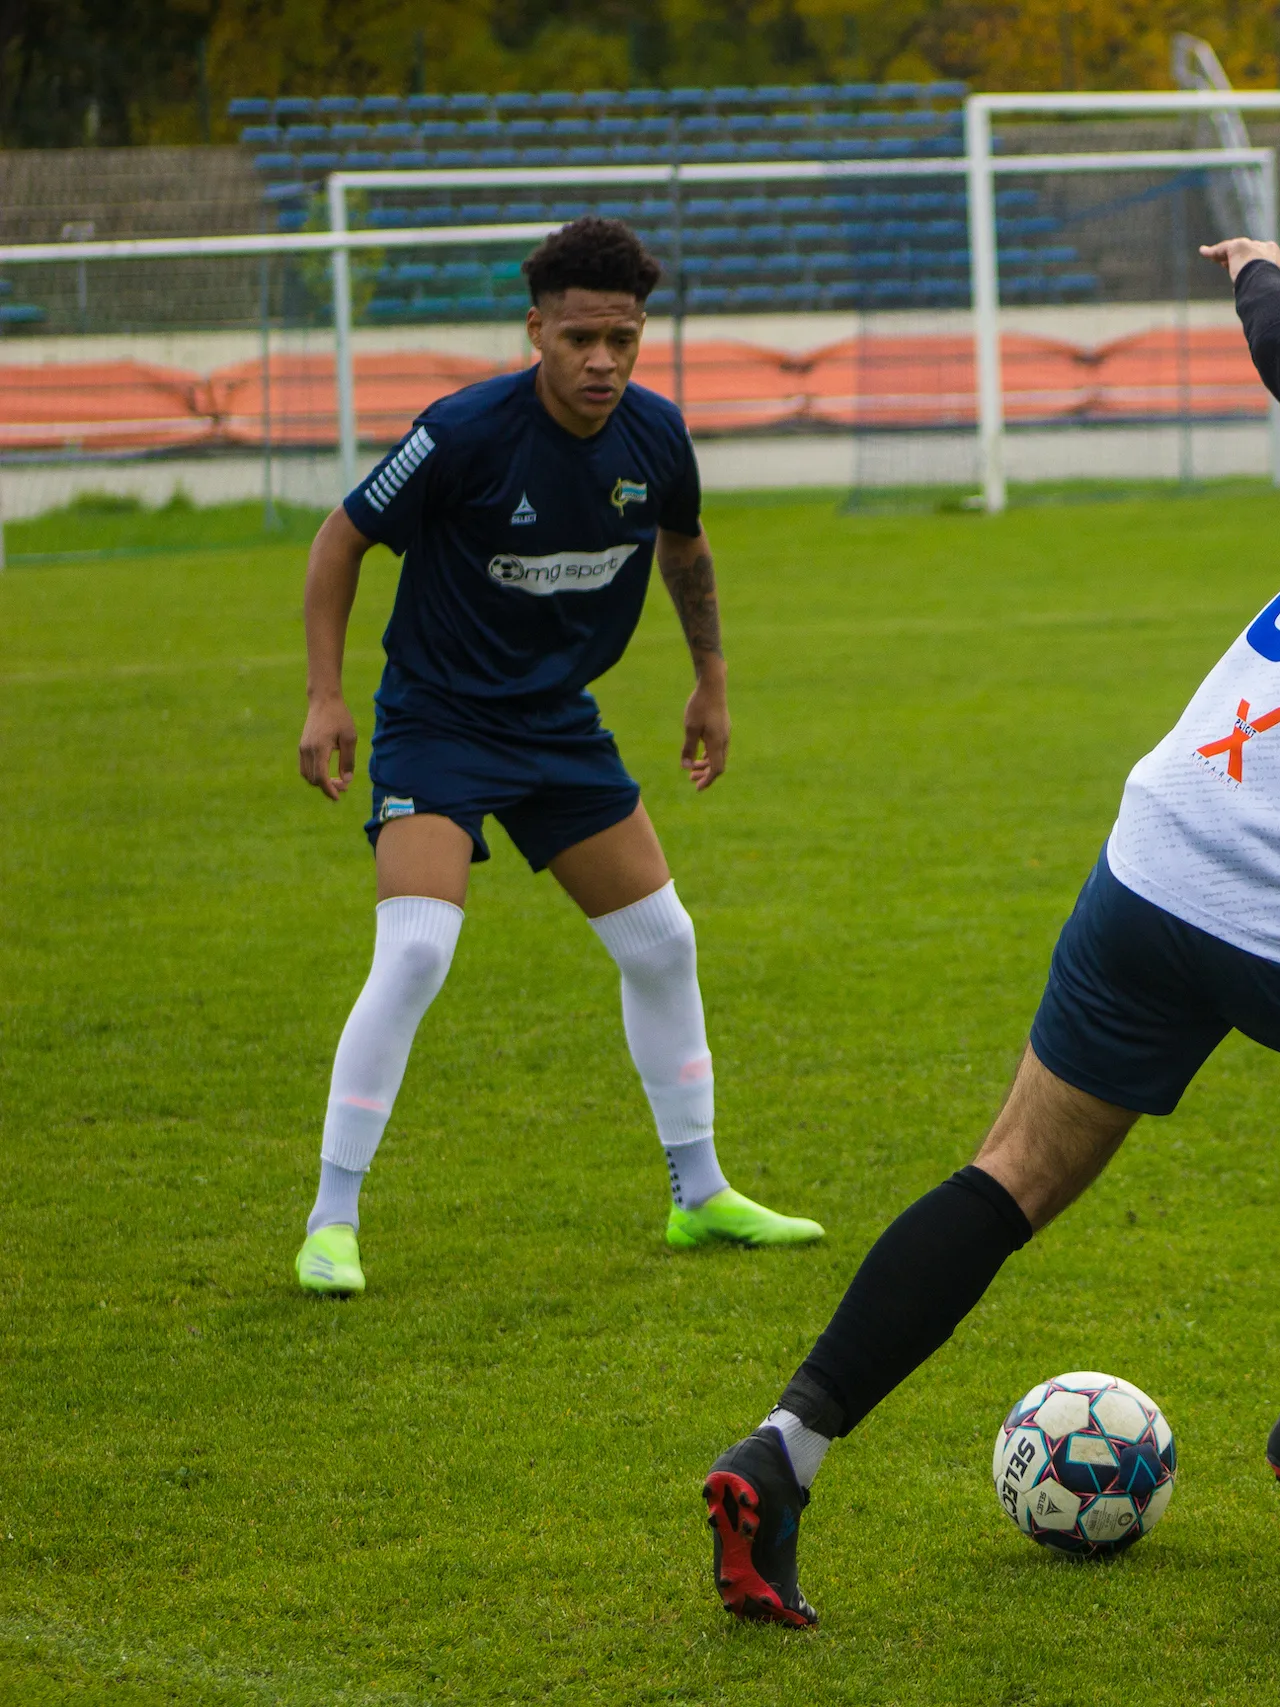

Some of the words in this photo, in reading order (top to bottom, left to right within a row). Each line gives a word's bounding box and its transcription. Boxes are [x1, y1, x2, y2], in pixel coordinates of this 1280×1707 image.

[511, 513, 537, 524] SELECT
[565, 557, 618, 579] sport
[1036, 1490, 1047, 1516] SELECT
